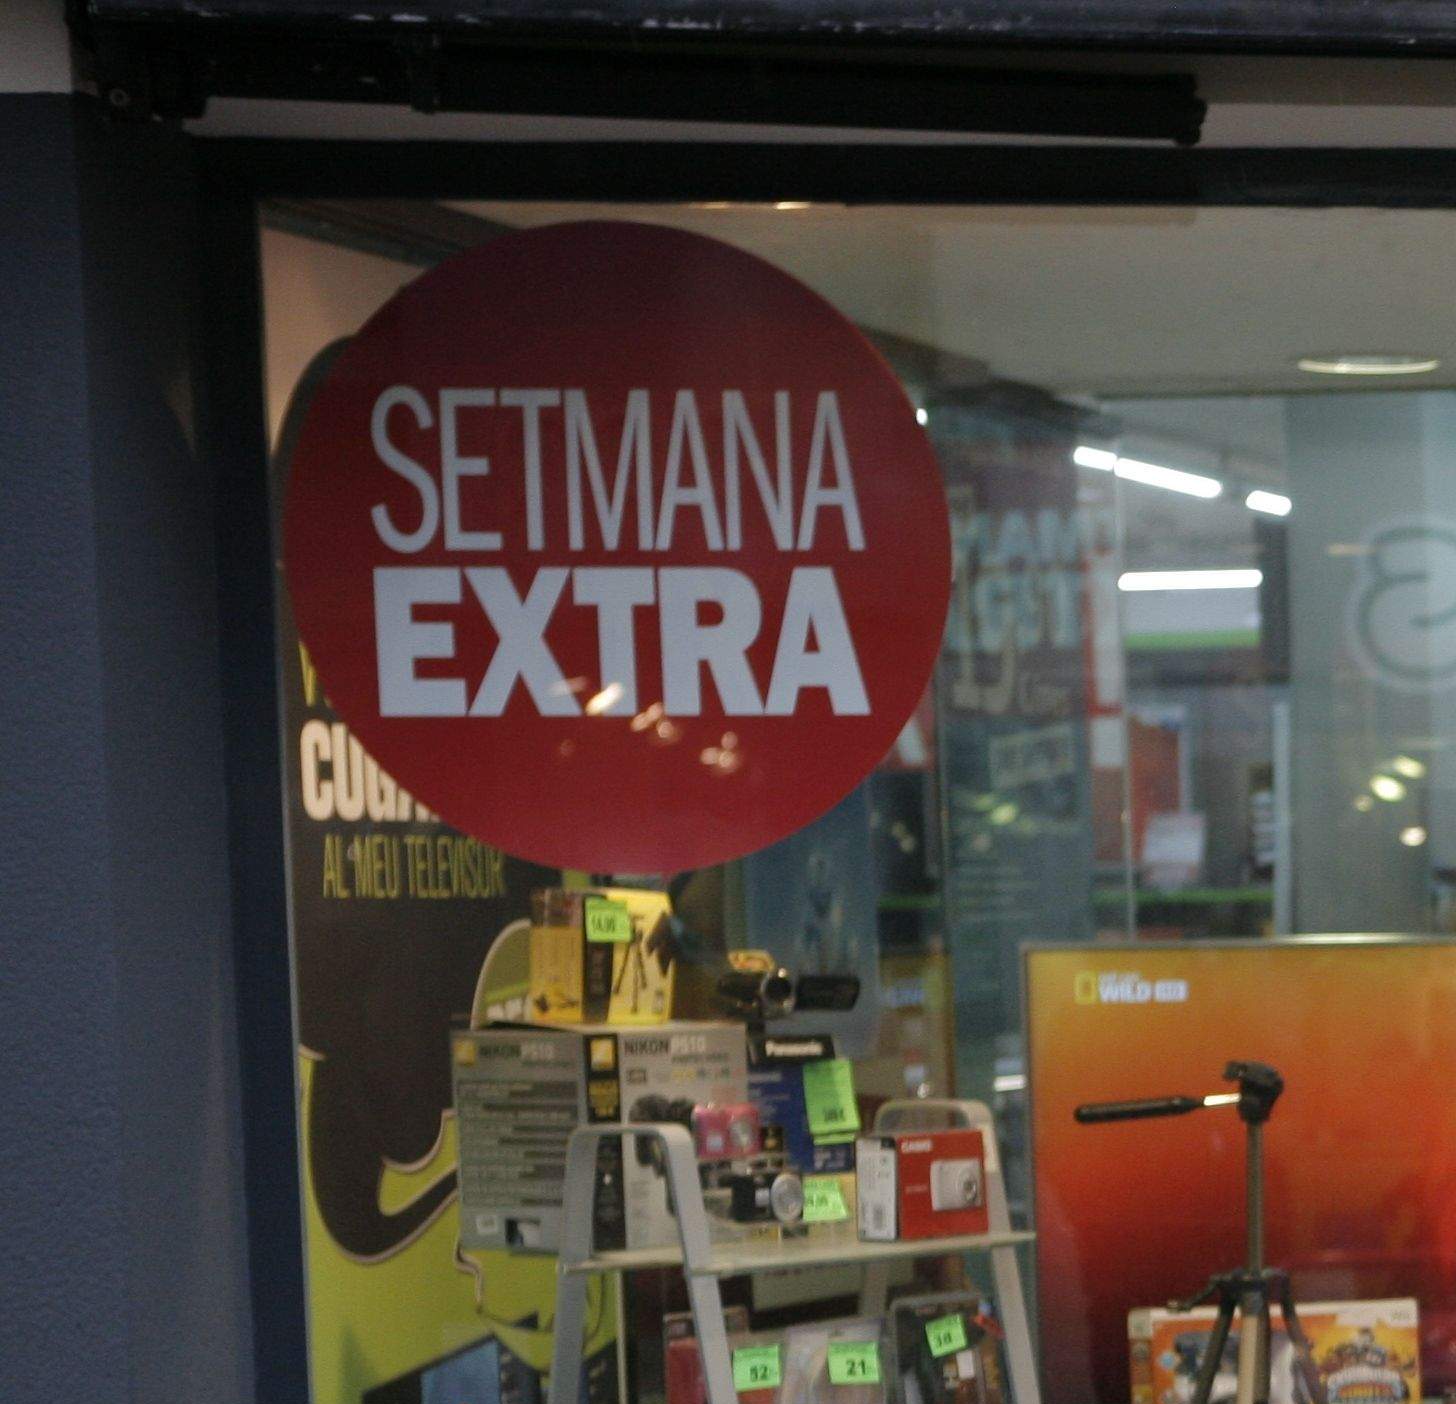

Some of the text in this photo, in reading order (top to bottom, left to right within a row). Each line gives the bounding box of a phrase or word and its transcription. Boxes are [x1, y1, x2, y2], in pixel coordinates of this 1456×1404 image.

[370, 383, 866, 555] SETMANA
[372, 565, 873, 718] EXTRA
[323, 834, 350, 899] AL
[355, 833, 401, 899] MEU
[624, 1039, 668, 1056] NIKON
[847, 1360, 866, 1376] 21
